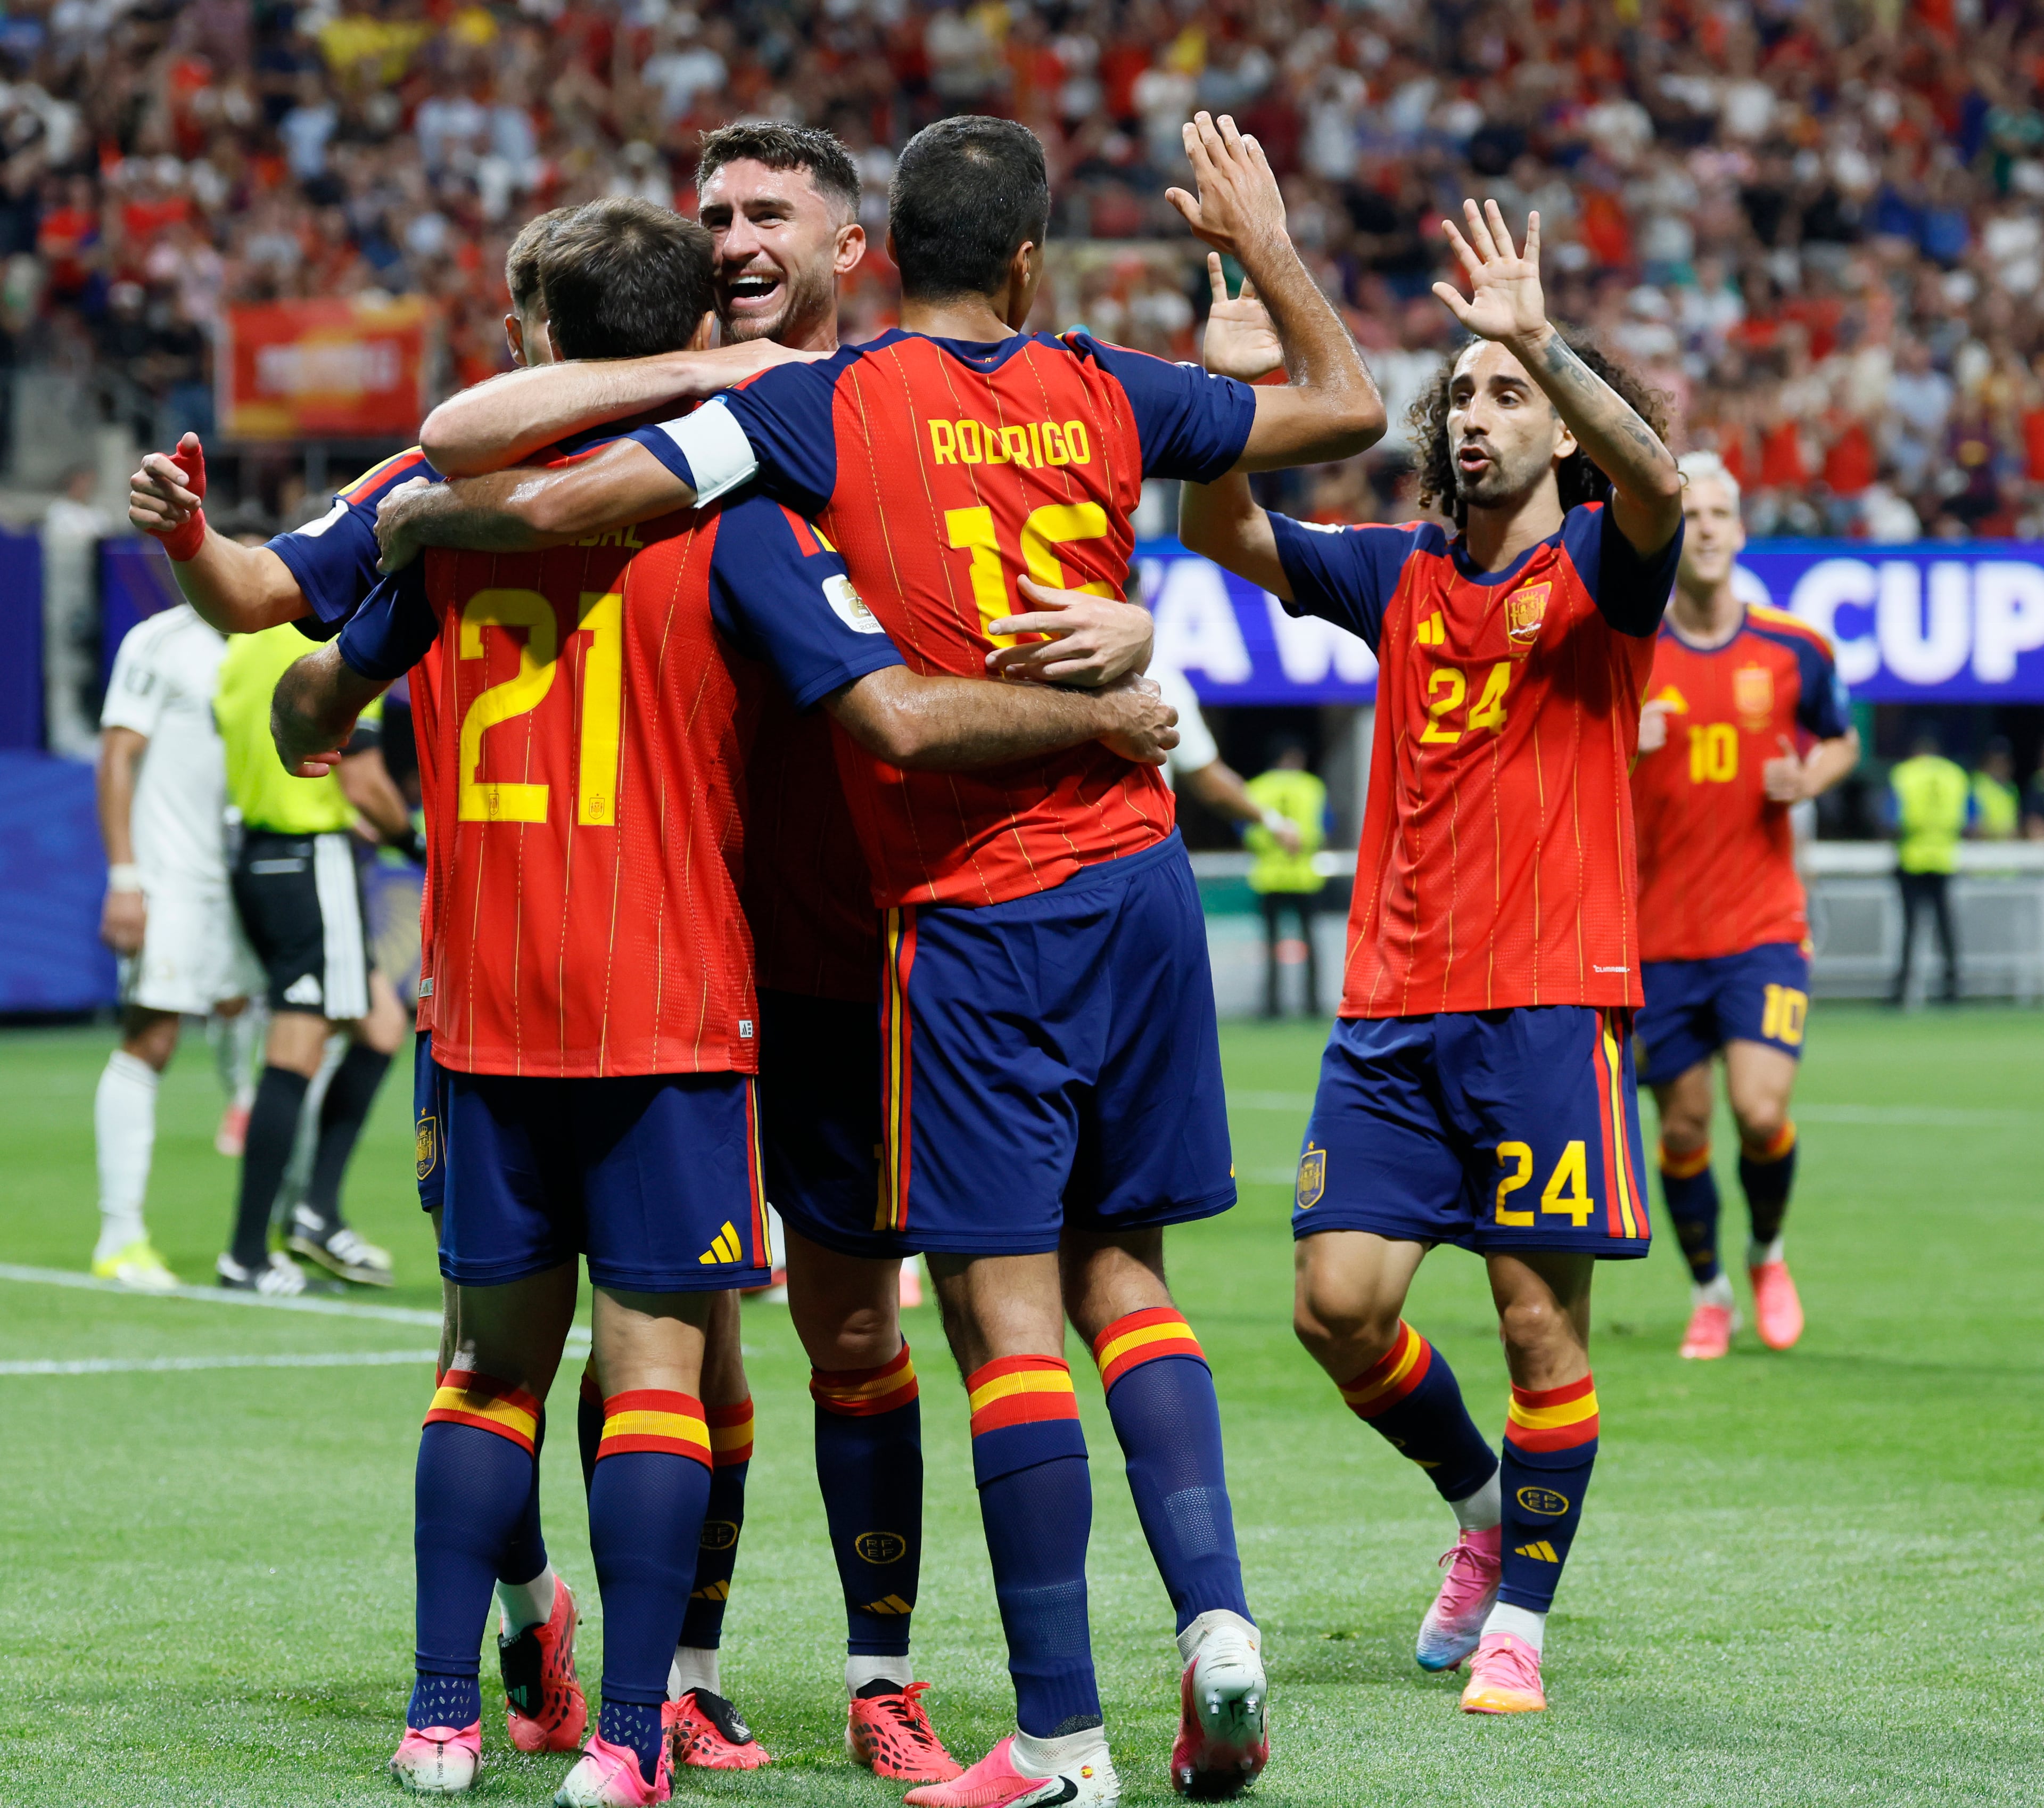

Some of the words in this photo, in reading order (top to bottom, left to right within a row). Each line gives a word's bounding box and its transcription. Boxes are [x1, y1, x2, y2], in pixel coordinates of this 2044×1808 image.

[927, 419, 1091, 469] RODRIGO
[1789, 558, 2044, 685] CUP
[458, 588, 623, 826] 21
[1420, 661, 1511, 744] 24
[1688, 722, 1738, 783] 10
[1761, 982, 1808, 1046] 10
[1495, 1140, 1594, 1227] 24
